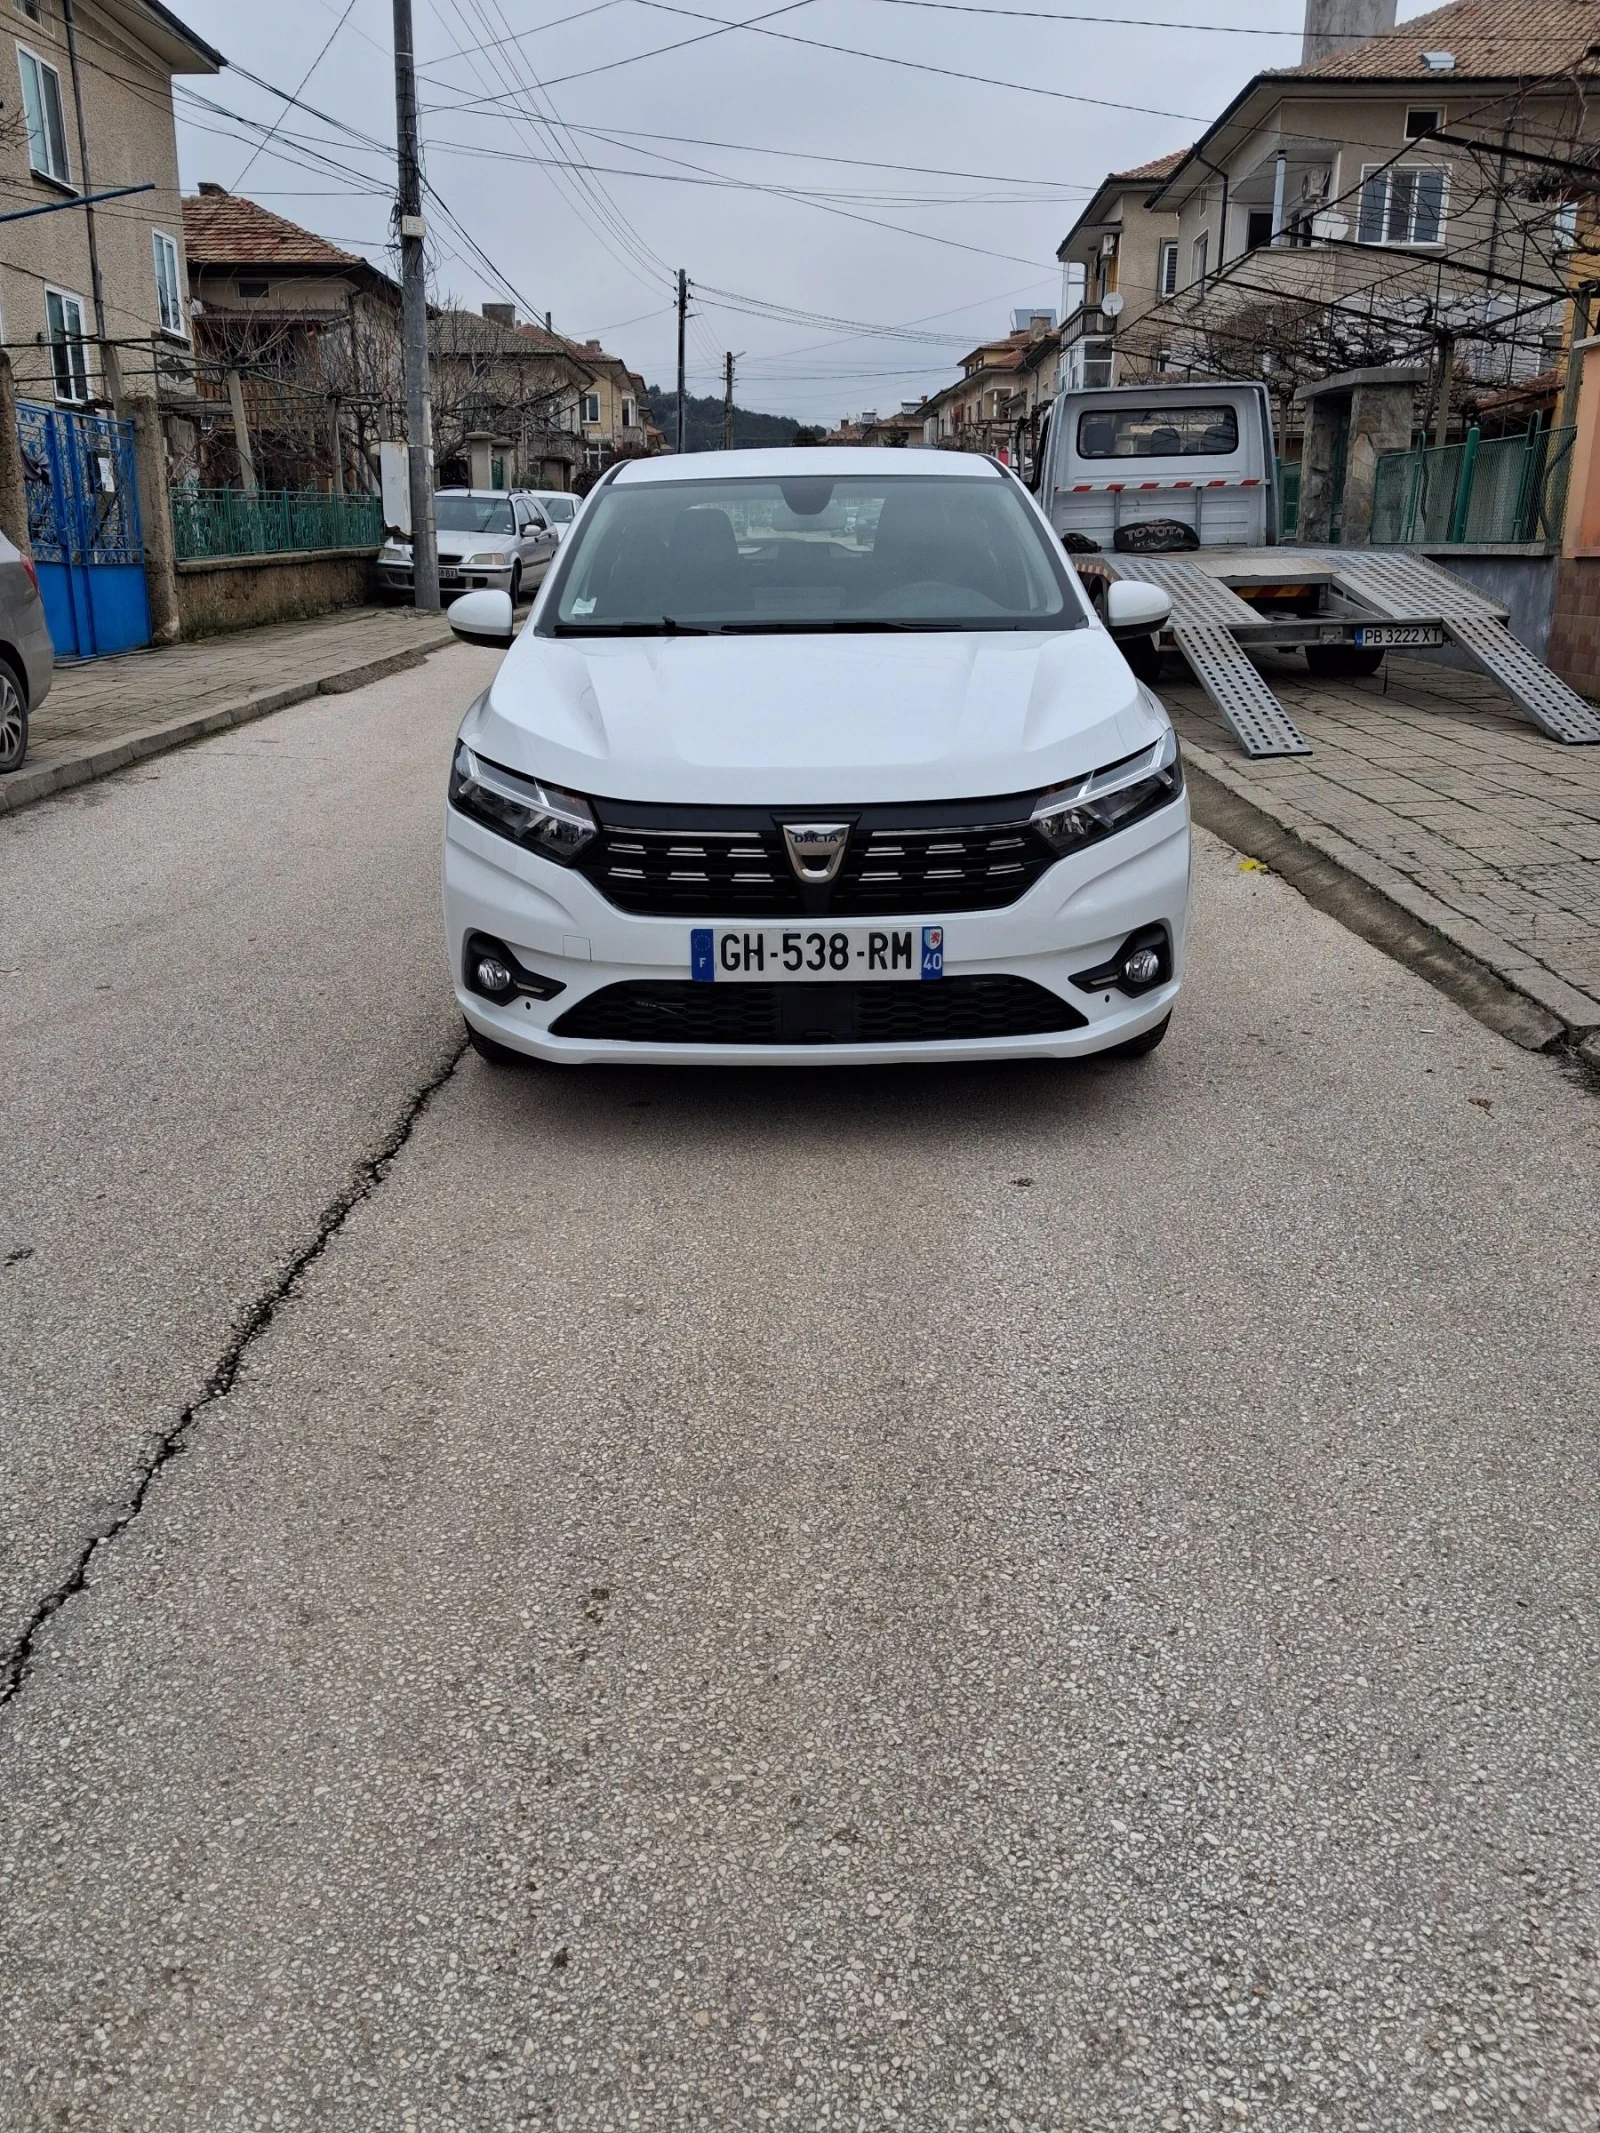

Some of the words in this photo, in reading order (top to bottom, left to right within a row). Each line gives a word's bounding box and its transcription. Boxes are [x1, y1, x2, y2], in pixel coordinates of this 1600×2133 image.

[1124, 525, 1185, 541] TOYOTA
[1364, 629, 1382, 644] PB
[1385, 628, 1419, 643] 3222
[1422, 627, 1441, 642] XT
[794, 834, 838, 843] DACIA
[720, 931, 912, 971] GH-538-RM
[699, 957, 706, 968] F
[923, 953, 942, 970] 40
